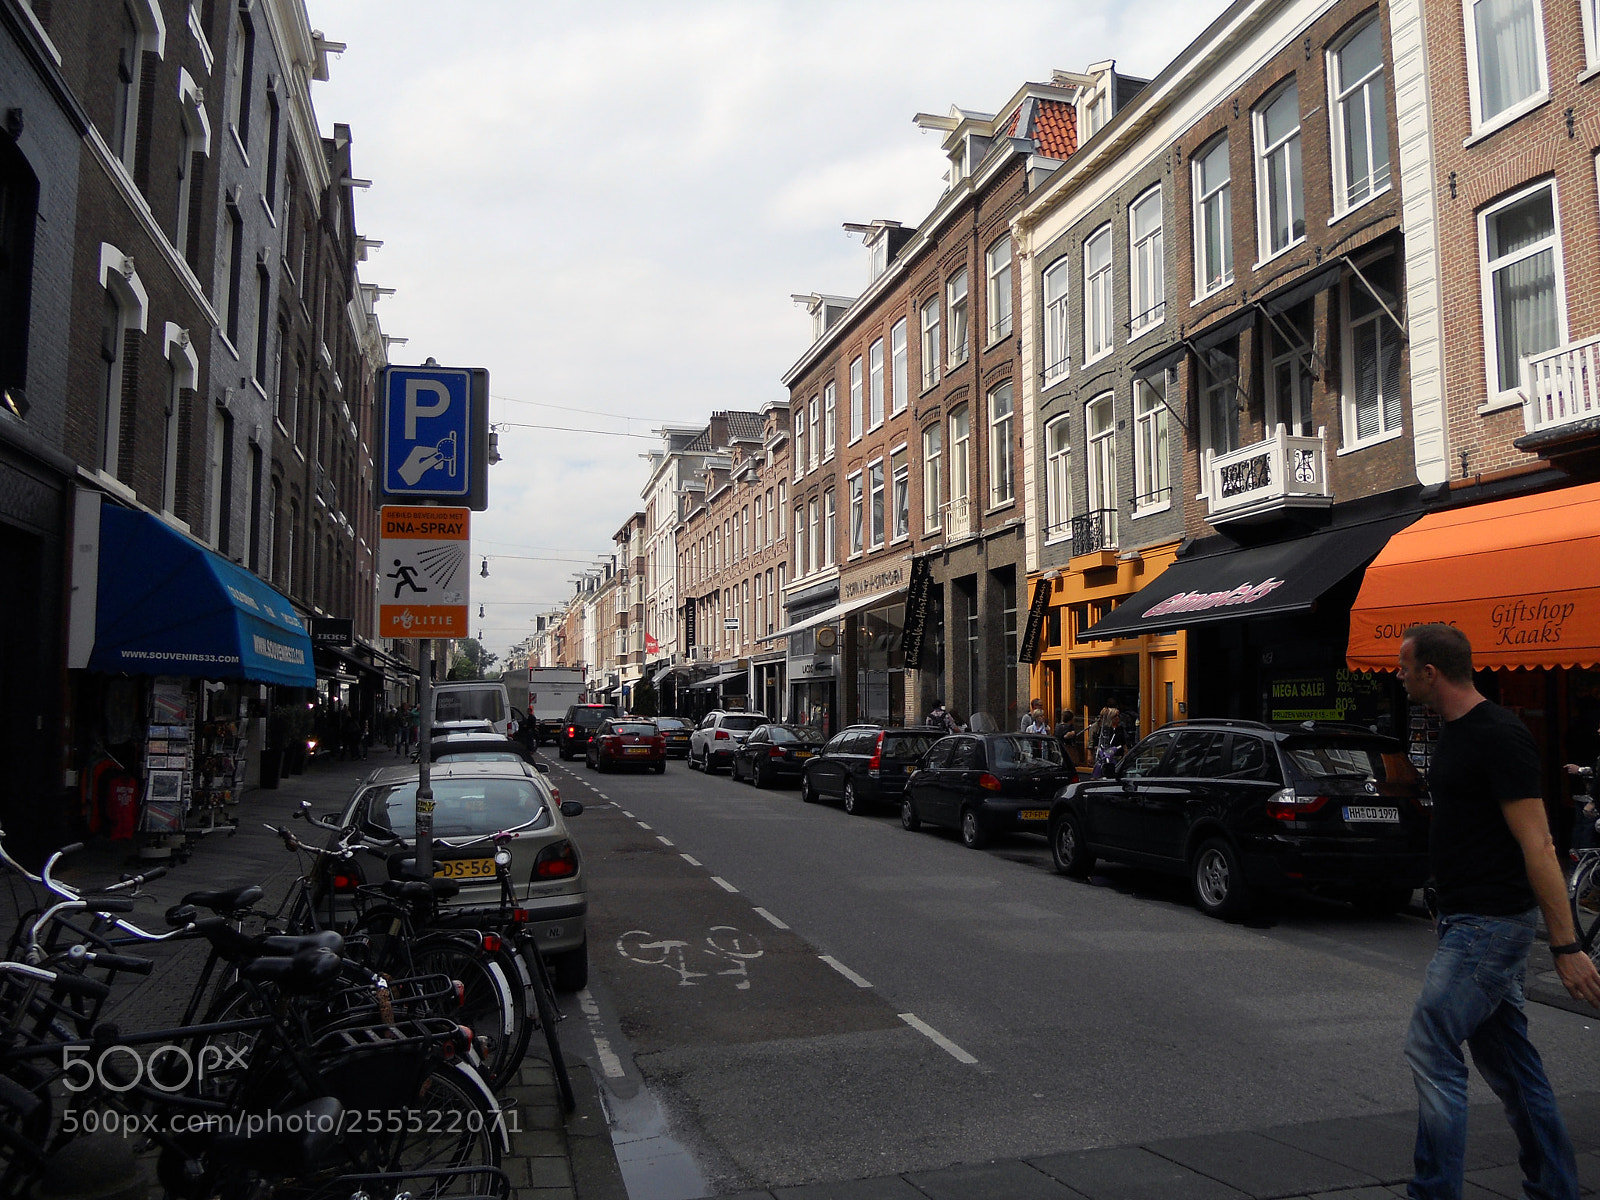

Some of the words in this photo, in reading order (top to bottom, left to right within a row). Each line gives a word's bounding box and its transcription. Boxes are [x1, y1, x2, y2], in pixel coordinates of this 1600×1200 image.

[405, 379, 450, 440] P
[387, 521, 463, 534] DNA-SPRAY
[1491, 598, 1575, 628] Giftshop
[1496, 620, 1562, 646] Kaaks
[121, 650, 240, 663] WWW.SOUVENIRS33.COM
[1272, 682, 1298, 698] MEGA
[1300, 680, 1325, 697] SALE!
[1335, 697, 1357, 711] 80%
[1349, 807, 1361, 818] HH
[1366, 808, 1377, 818] CD
[1378, 809, 1398, 819] 1997
[443, 861, 492, 877] DS-56
[549, 928, 561, 937] NL
